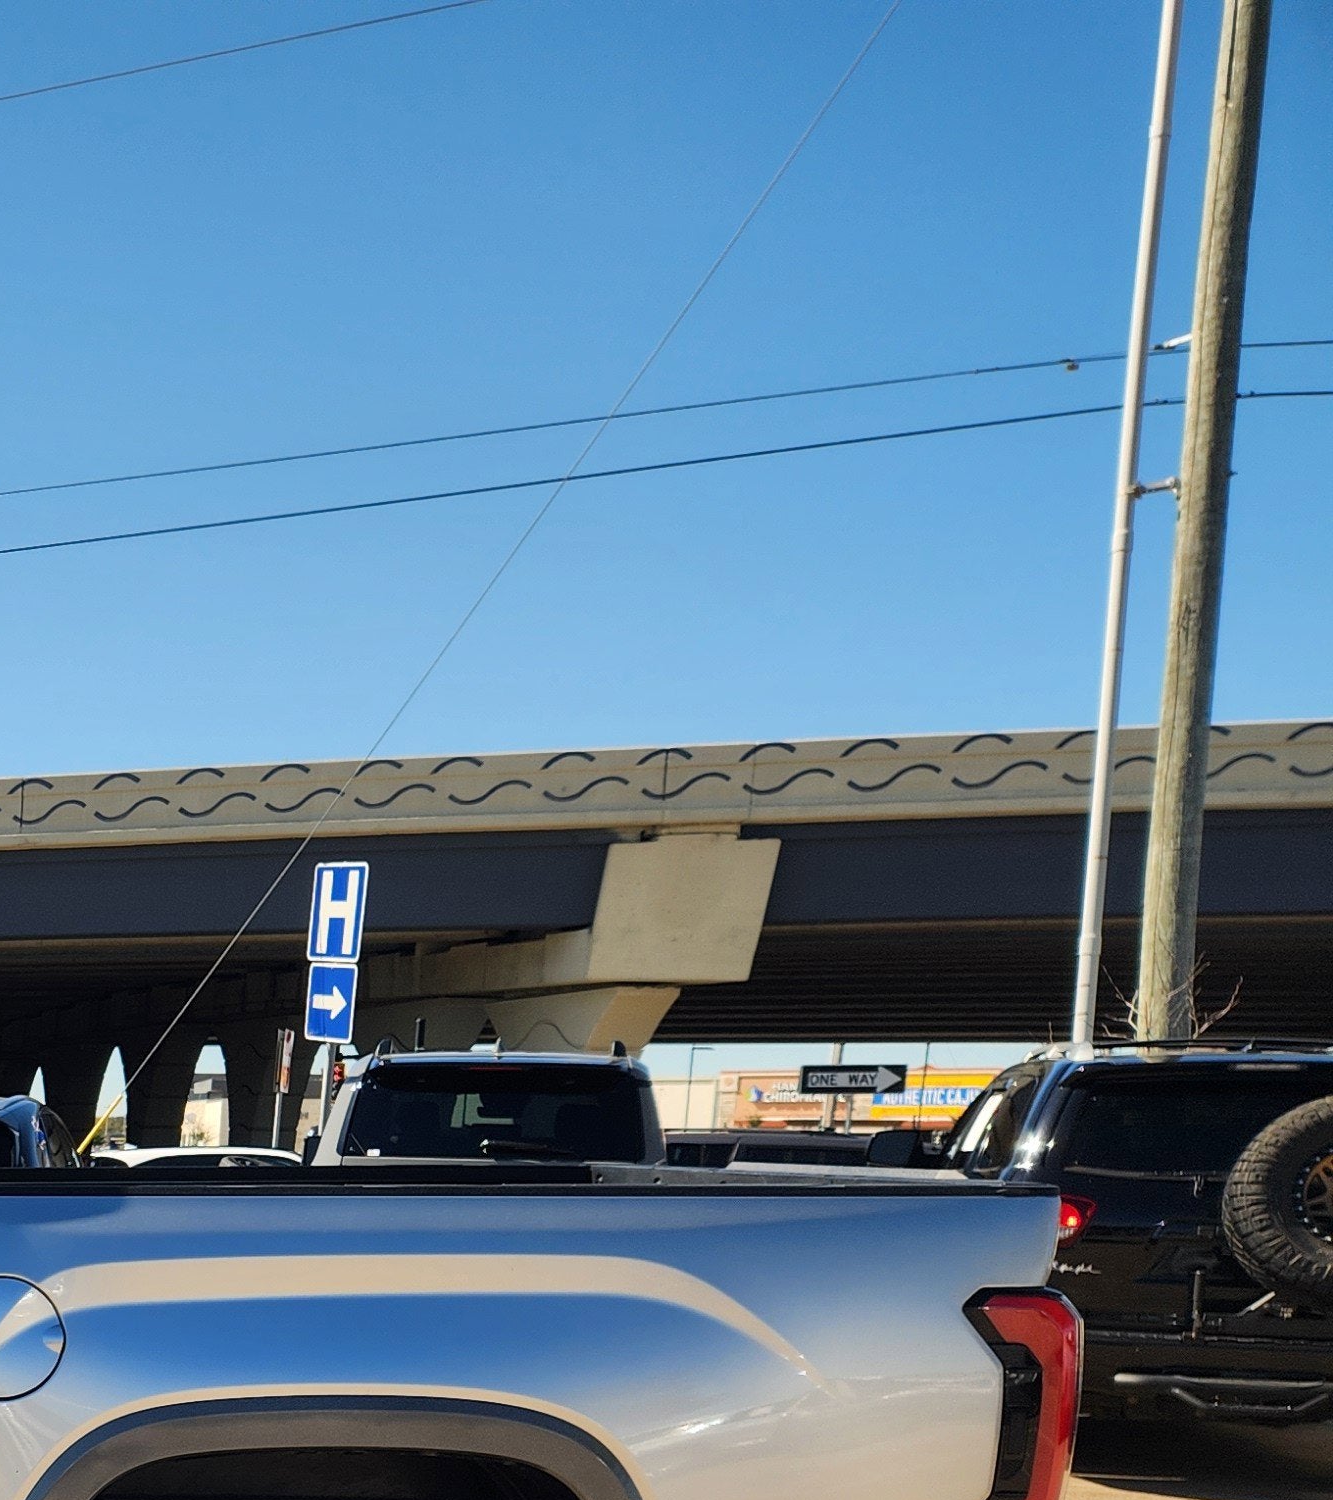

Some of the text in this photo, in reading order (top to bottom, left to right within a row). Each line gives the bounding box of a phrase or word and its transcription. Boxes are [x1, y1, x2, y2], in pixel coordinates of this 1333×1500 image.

[315, 870, 360, 955] H
[810, 1074, 878, 1086] ONE WAY
